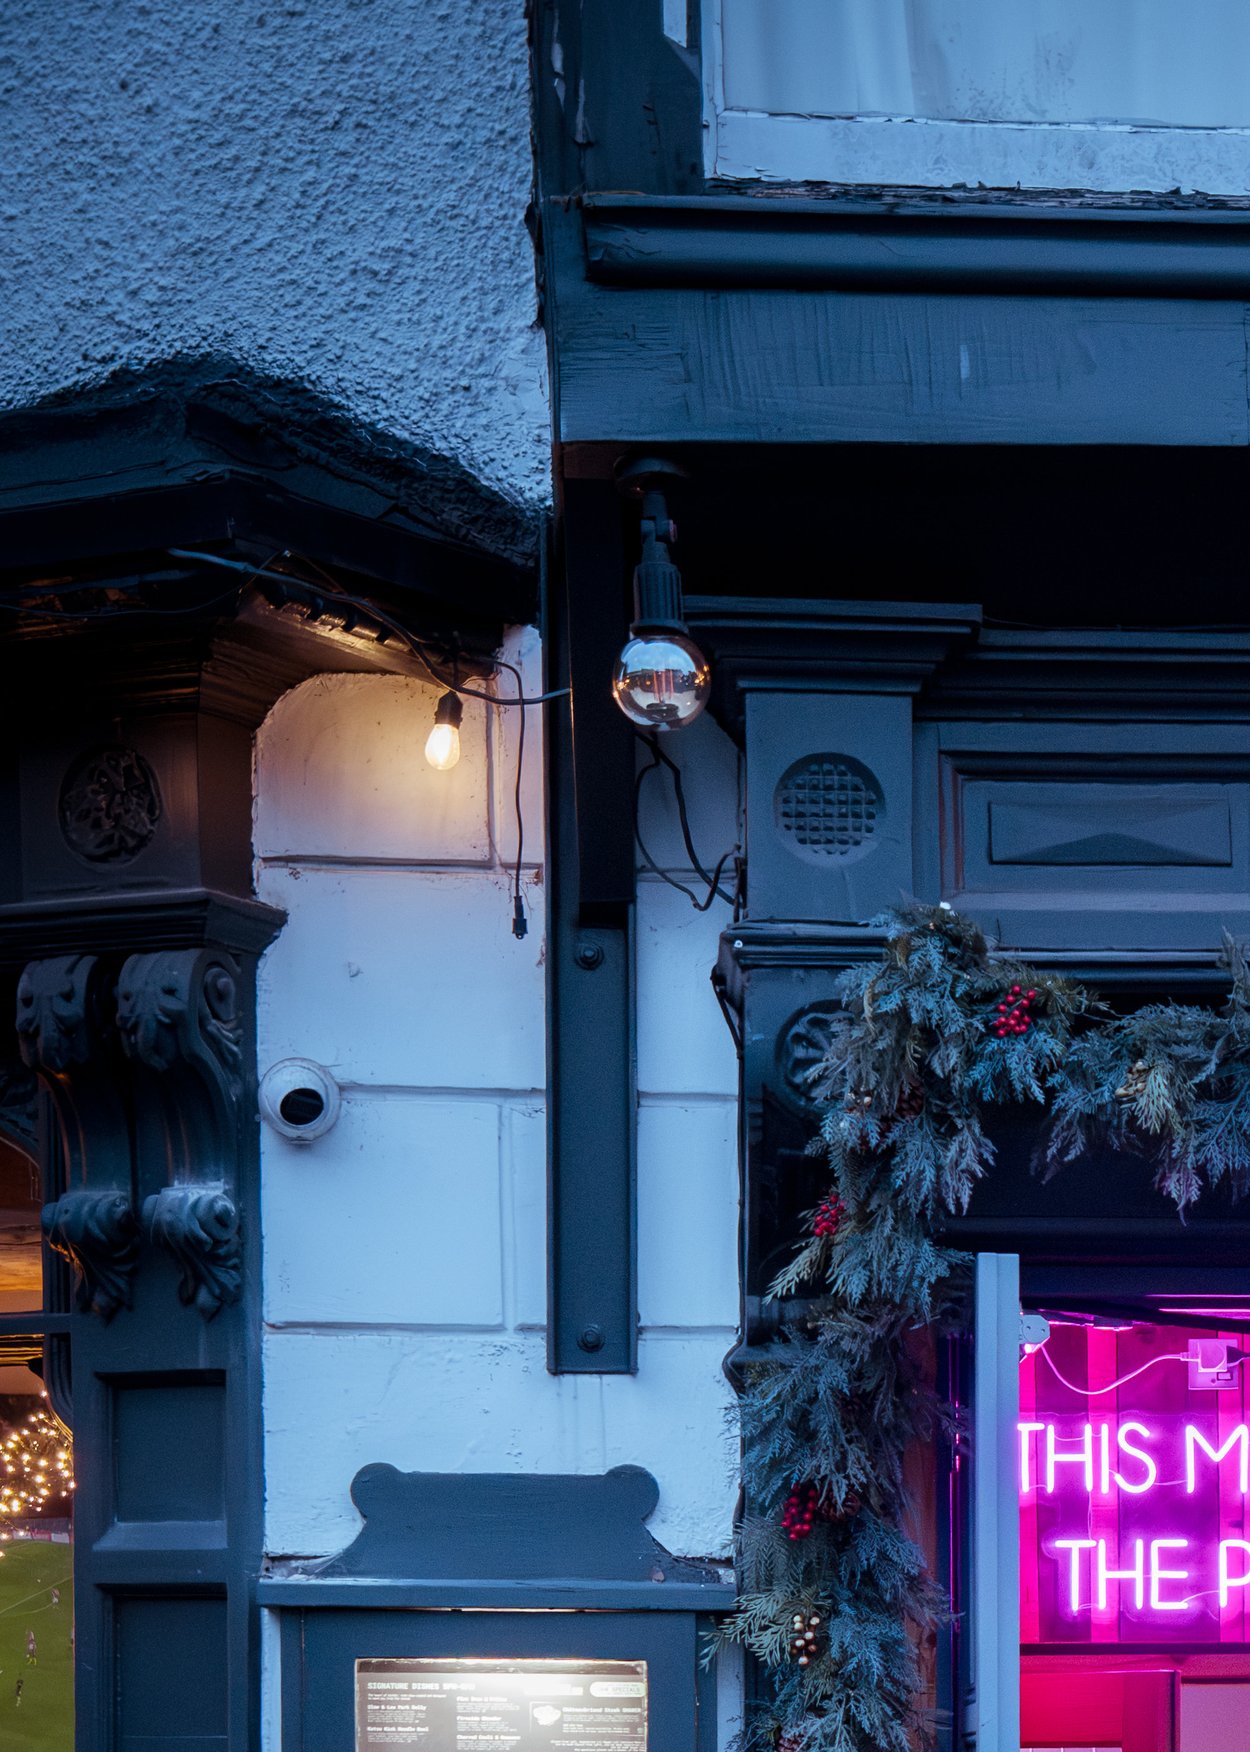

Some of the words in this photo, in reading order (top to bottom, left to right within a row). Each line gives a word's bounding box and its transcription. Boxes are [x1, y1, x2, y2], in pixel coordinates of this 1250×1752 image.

[1017, 1422, 1157, 1494] THIS
[1054, 1538, 1190, 1611] THE
[367, 1682, 409, 1690] SIGNATURE
[412, 1682, 440, 1690] DISHES
